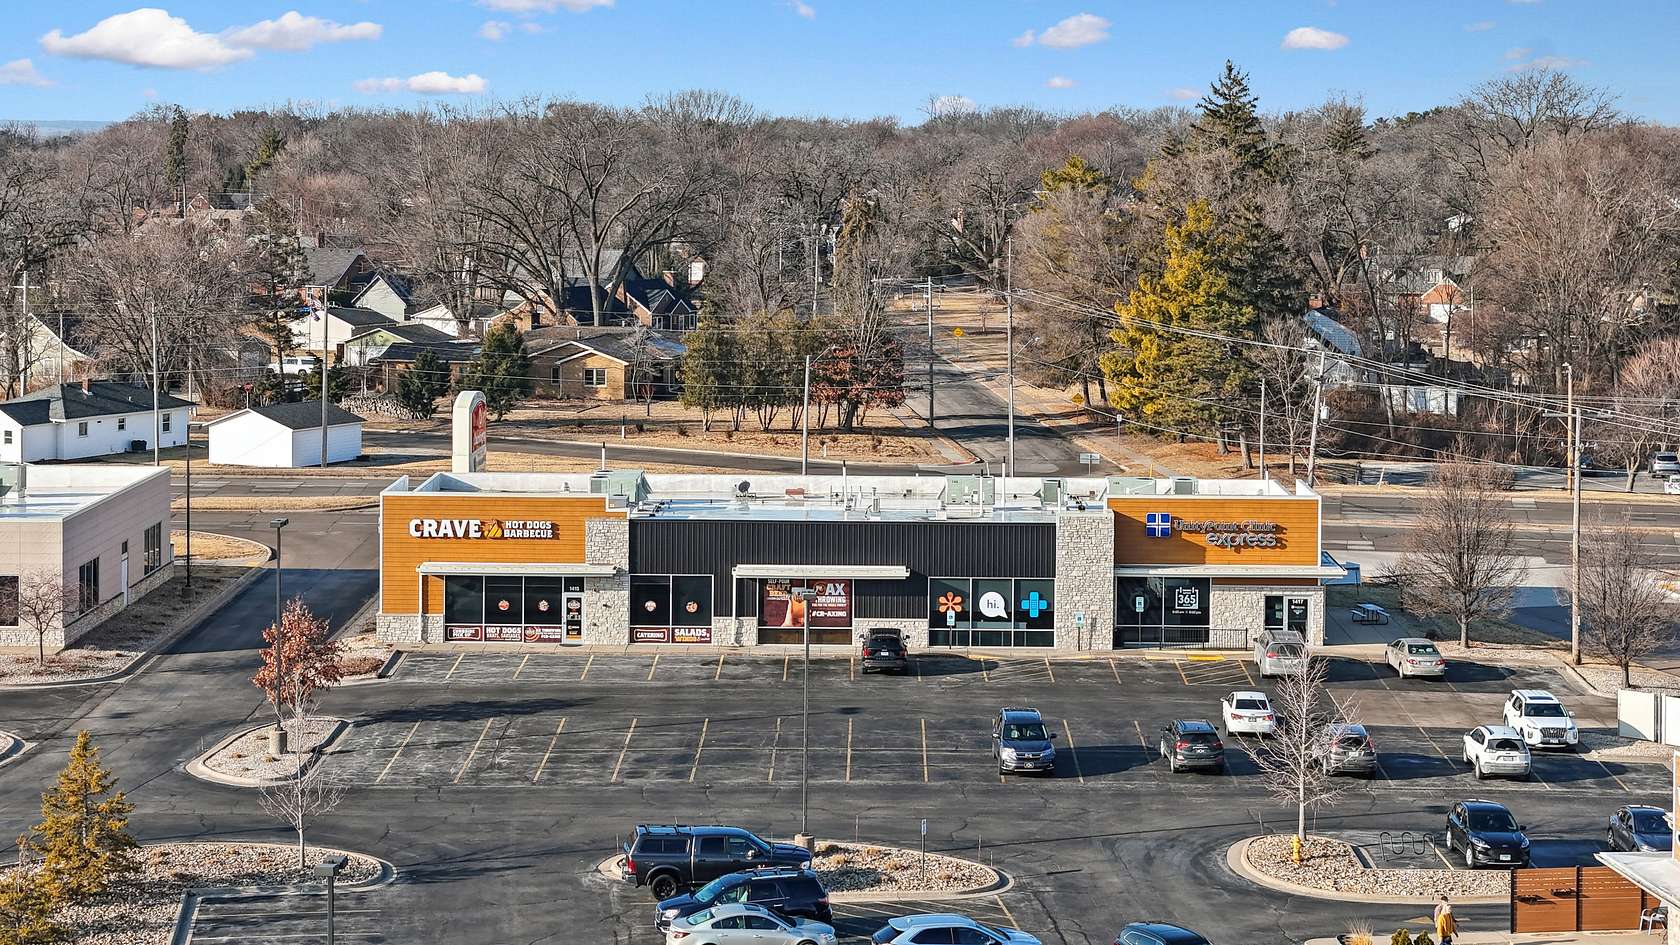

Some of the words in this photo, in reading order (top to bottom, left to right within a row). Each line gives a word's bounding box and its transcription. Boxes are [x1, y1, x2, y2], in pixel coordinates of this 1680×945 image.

[408, 518, 482, 538] CRAVE
[505, 520, 524, 529] HOT
[526, 520, 552, 529] DOGS
[1174, 519, 1239, 533] UnityPoint
[1240, 519, 1277, 532] Clinic
[503, 529, 553, 538] BARBECUE
[1206, 532, 1277, 550] express
[825, 583, 846, 596] AX
[986, 599, 1000, 609] hi.
[1178, 594, 1196, 604] 365
[674, 628, 710, 637] SALADS,
